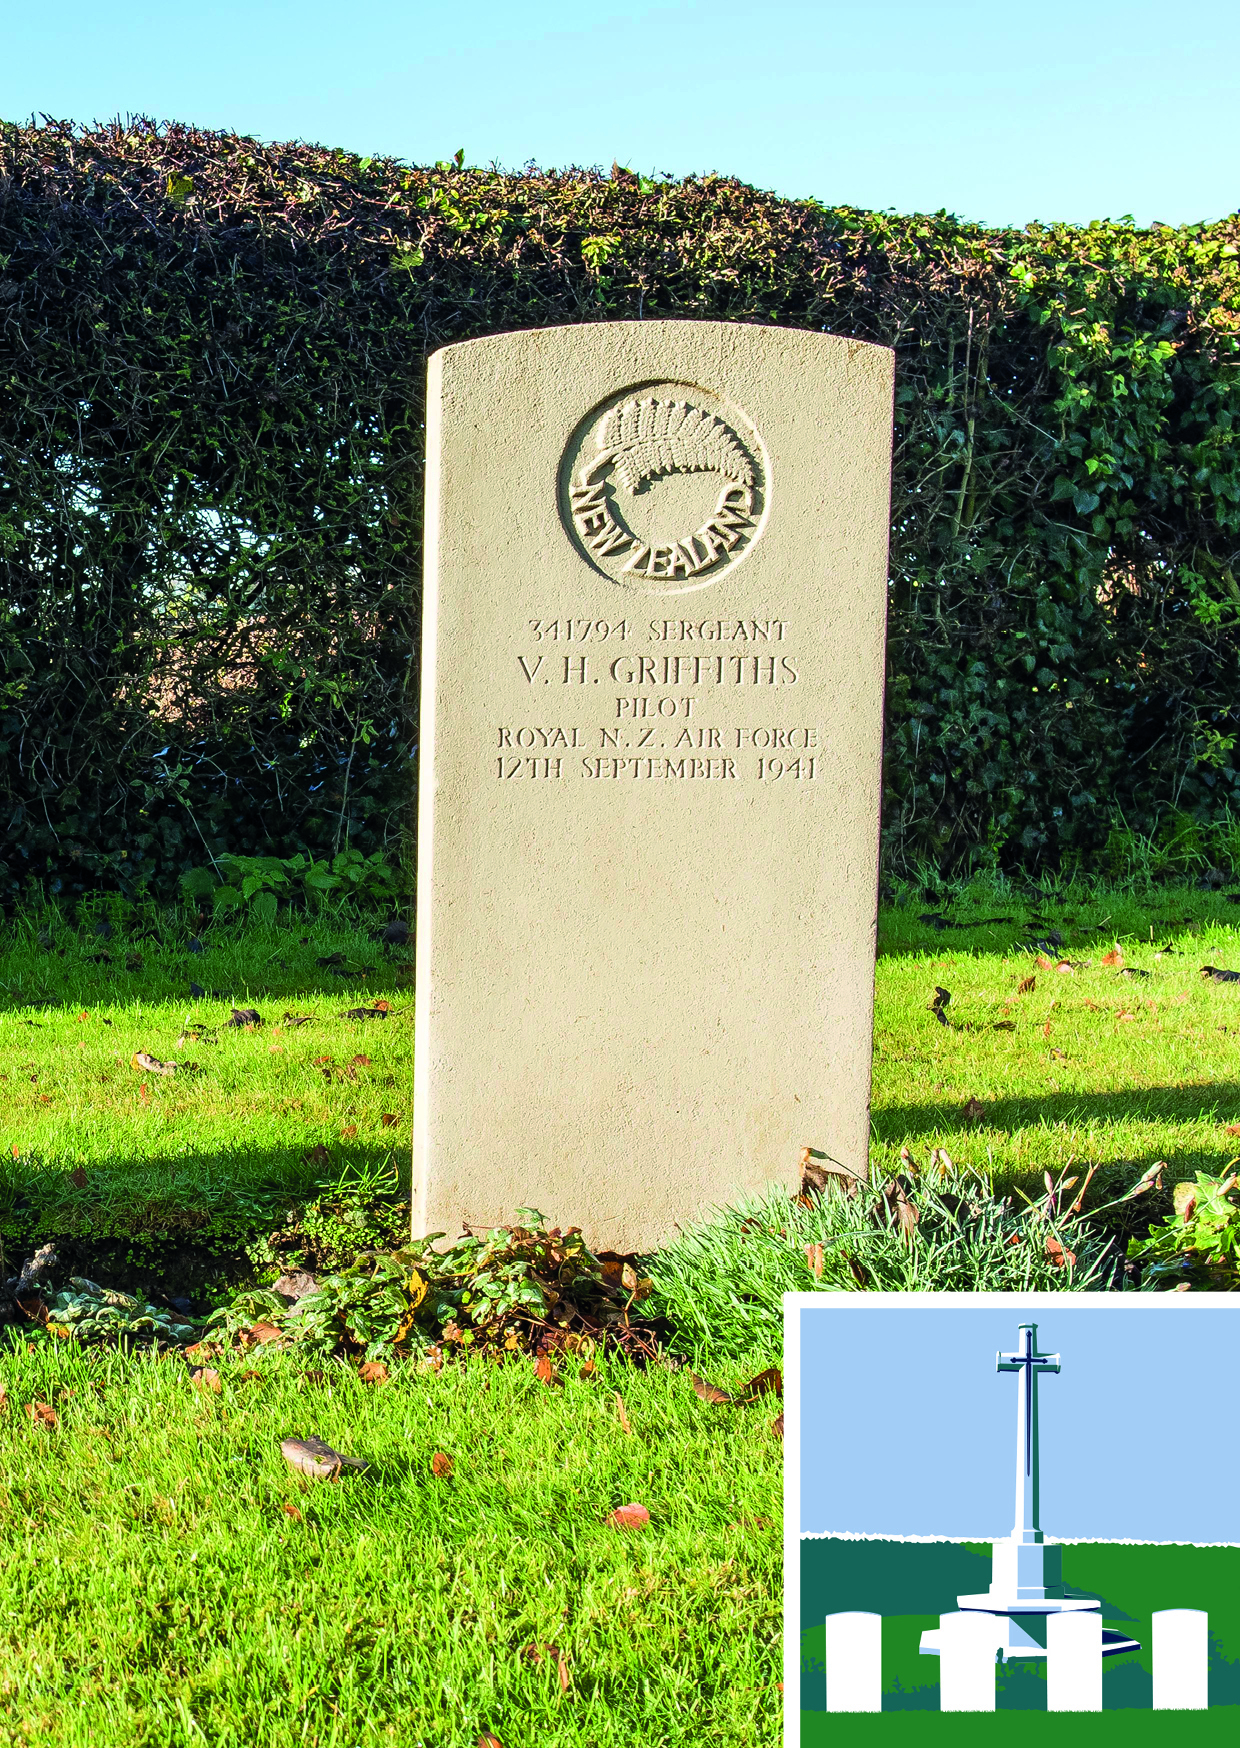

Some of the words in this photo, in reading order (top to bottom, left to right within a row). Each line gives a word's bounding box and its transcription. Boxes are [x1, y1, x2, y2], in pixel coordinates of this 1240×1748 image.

[569, 480, 634, 557] NEW
[622, 482, 757, 579] ZEALAND
[528, 619, 632, 642] 341794
[649, 619, 790, 642] SERGEANT
[517, 656, 550, 685] V.
[563, 656, 599, 685] H.
[610, 656, 800, 685] GRIFFITHS
[616, 697, 697, 718] PILOT
[497, 728, 586, 748] ROYAL
[600, 728, 630, 748] N.
[640, 728, 666, 748] Z.
[675, 728, 722, 748] AIR
[736, 728, 817, 748] FORCE
[496, 757, 563, 779] 12TH
[581, 757, 740, 779] SEPTEMBER
[758, 757, 817, 781] 1941
